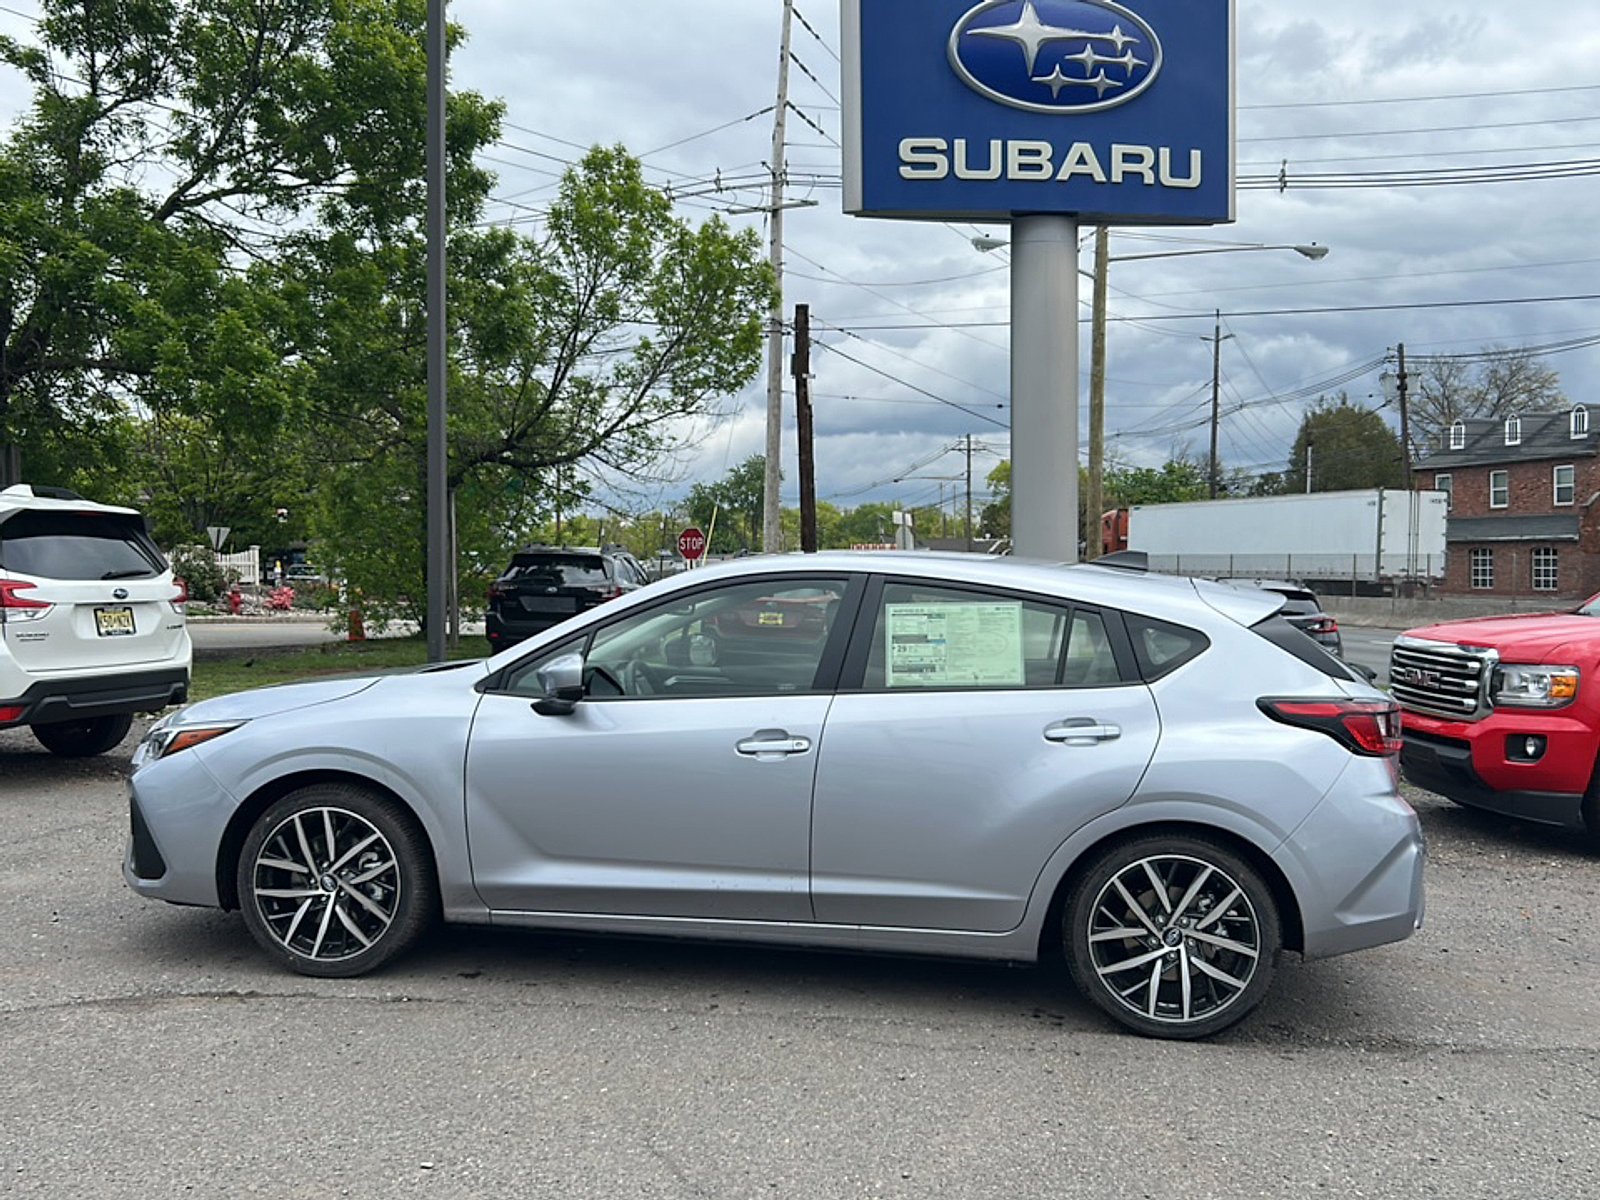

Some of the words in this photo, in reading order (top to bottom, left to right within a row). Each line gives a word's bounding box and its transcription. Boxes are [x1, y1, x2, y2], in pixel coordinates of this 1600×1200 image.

[898, 137, 1202, 189] SUBARU
[680, 537, 703, 550] STOP
[1404, 667, 1440, 689] GMC
